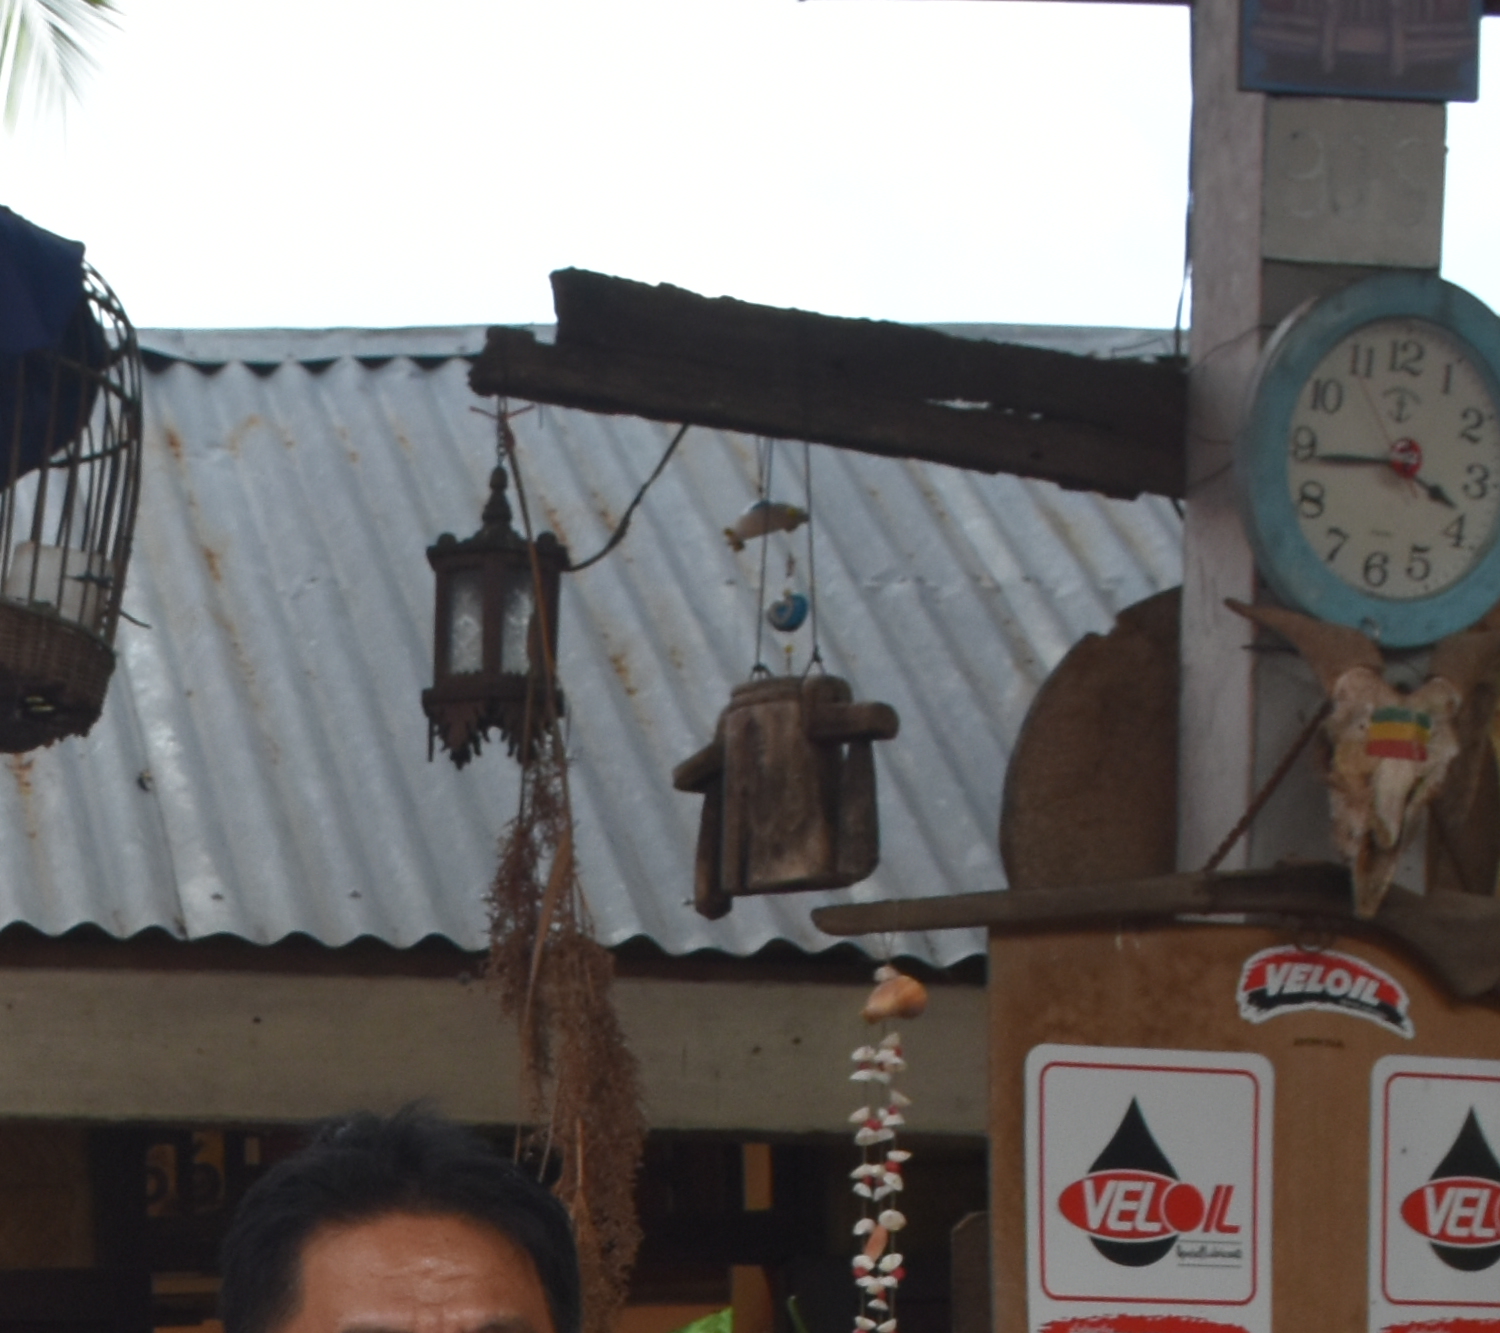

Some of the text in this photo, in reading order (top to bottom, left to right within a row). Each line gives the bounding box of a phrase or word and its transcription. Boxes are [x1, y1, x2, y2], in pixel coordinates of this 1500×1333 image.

[1349, 344, 1375, 378] 11
[1389, 340, 1425, 376] 12
[1311, 379, 1344, 413] 10
[1441, 364, 1453, 395] 1
[1460, 407, 1484, 444] 2
[1294, 426, 1317, 461] 9
[1464, 464, 1489, 500] 3
[1298, 481, 1324, 519] 8
[1325, 527, 1349, 562] 7
[1442, 514, 1466, 547] 4
[1364, 552, 1387, 587] 6
[1406, 545, 1430, 581] 5
[1265, 962, 1381, 1006] VELOIL
[1081, 1179, 1241, 1238] VELOIL
